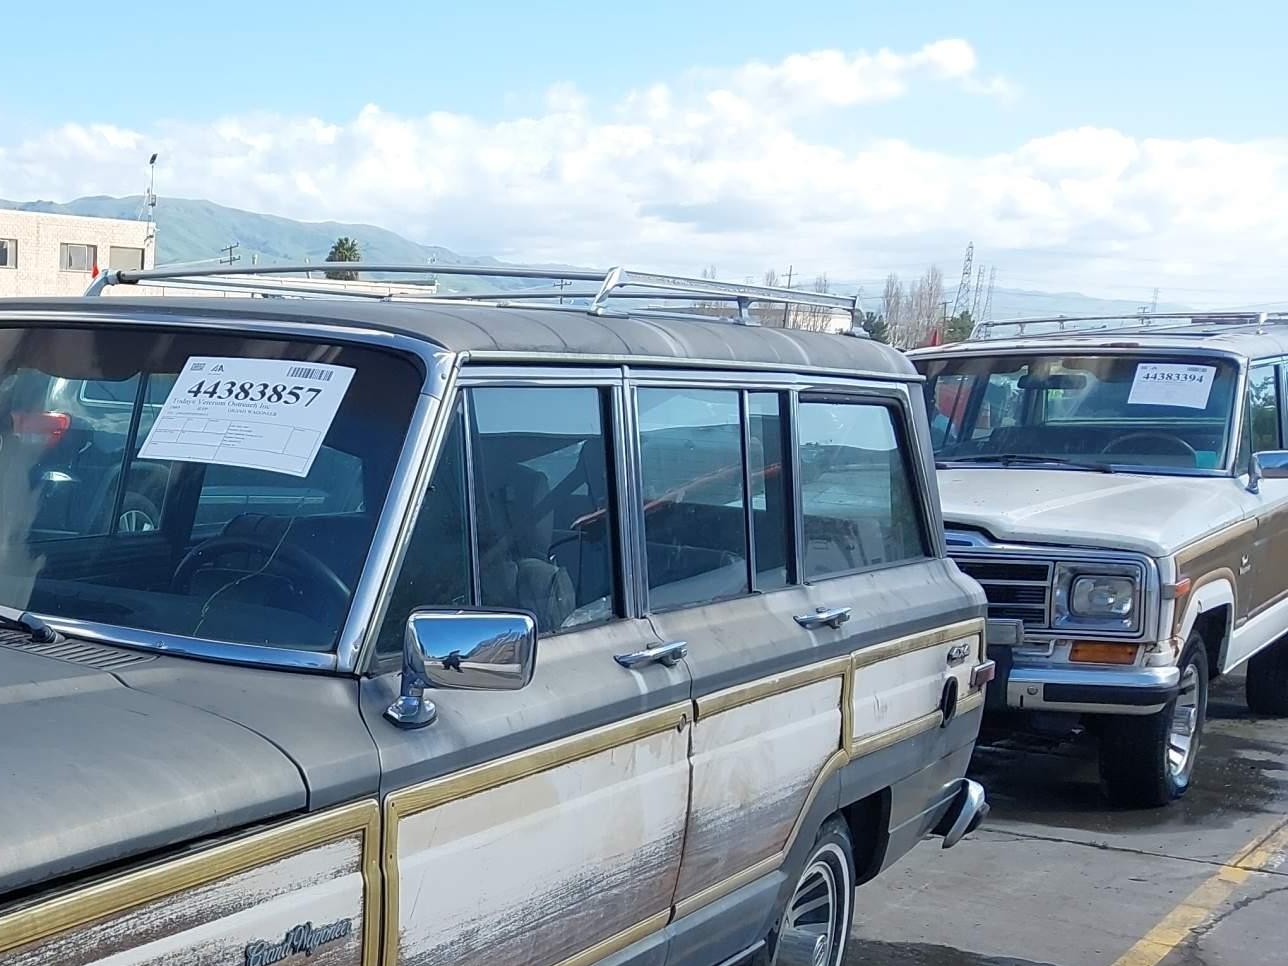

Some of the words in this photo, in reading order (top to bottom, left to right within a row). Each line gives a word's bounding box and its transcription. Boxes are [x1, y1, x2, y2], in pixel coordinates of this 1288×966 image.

[1143, 373, 1203, 383] 44383394
[187, 379, 322, 408] 44383857
[292, 918, 352, 957] Wagoneer
